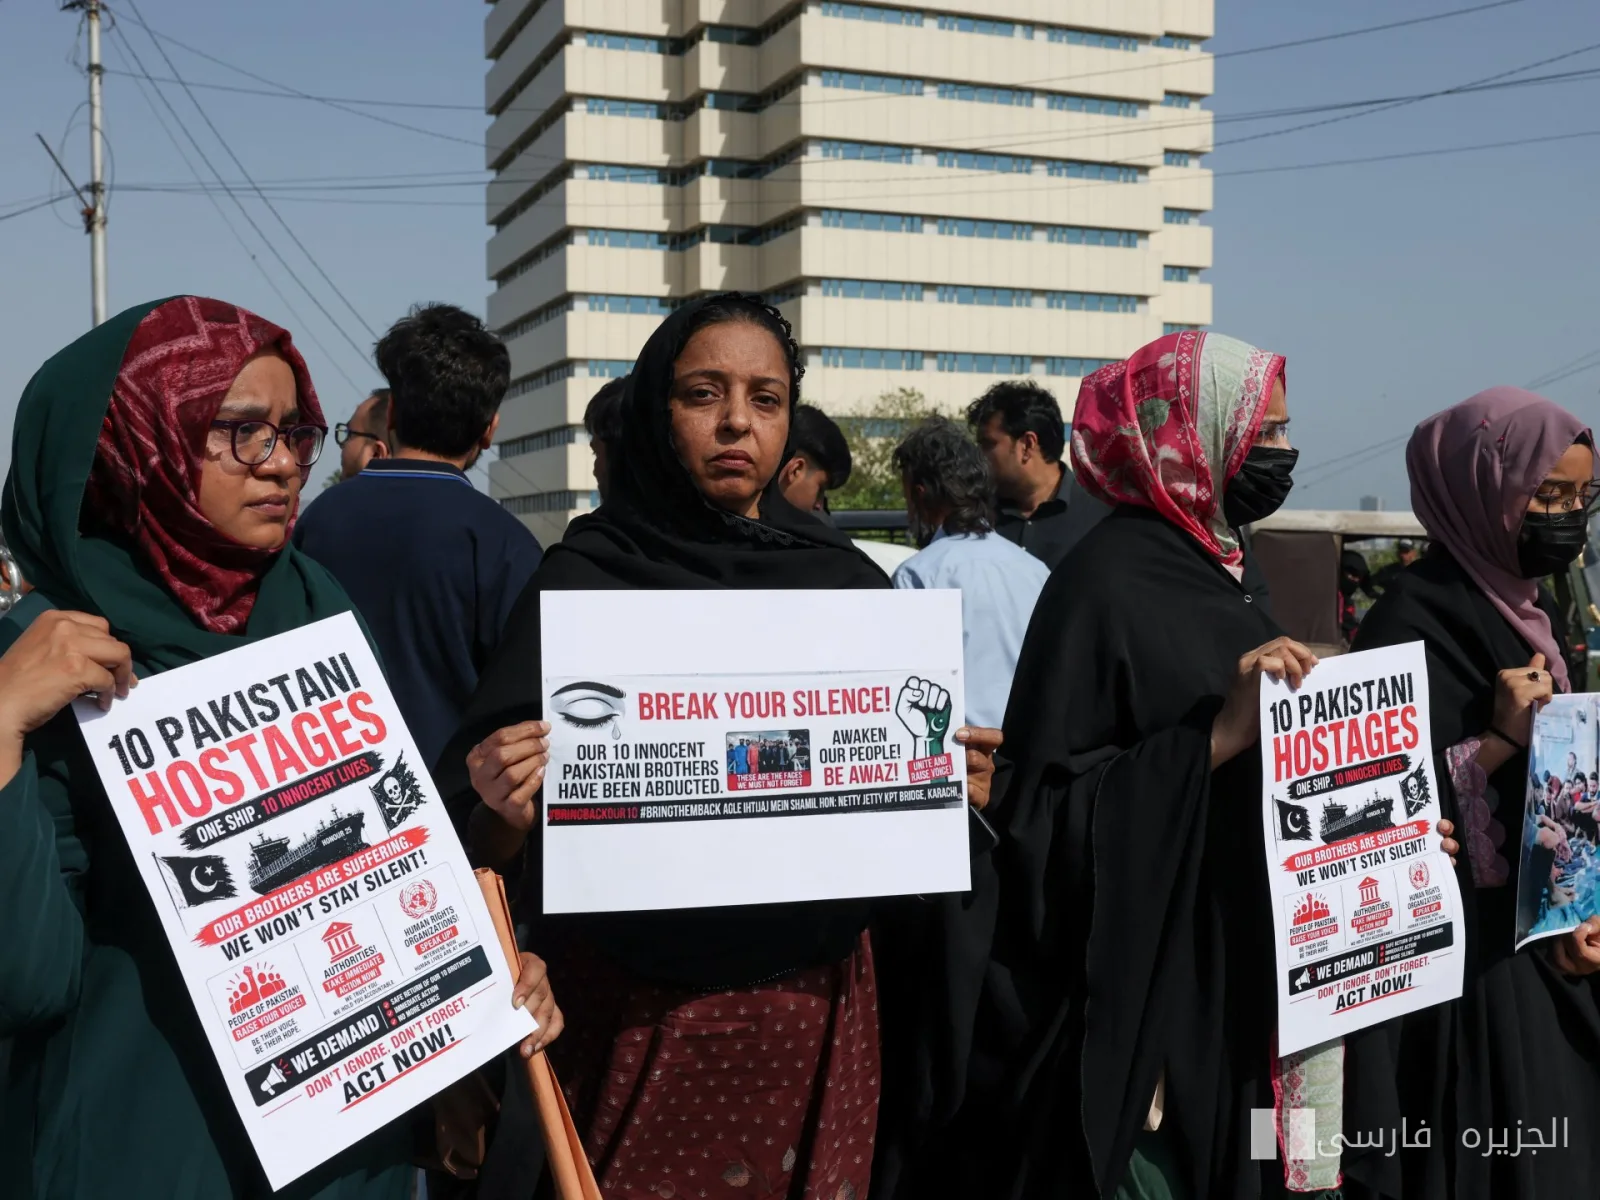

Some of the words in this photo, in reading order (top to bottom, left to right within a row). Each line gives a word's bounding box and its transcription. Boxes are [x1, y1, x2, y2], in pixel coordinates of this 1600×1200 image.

[105, 724, 156, 777] 10
[153, 651, 362, 759] PAKISTANI
[638, 692, 718, 720] BREAK
[724, 691, 786, 718] YOUR
[792, 686, 890, 716] SILENCE!
[1269, 696, 1292, 734] 10
[1298, 671, 1414, 727] PAKISTANI
[577, 744, 606, 760] OUR
[612, 743, 629, 760] 10
[634, 741, 705, 759] INNOCENT
[819, 747, 845, 763] OUR
[849, 743, 900, 761] PEOPLE!
[832, 727, 886, 745] AWAKEN
[1272, 704, 1419, 782] HOSTAGES
[124, 689, 390, 836] HOSTAGES
[562, 762, 639, 780] PAKISTANI
[644, 759, 718, 778] BROTHERS
[736, 773, 756, 781] THESE
[757, 772, 769, 780] ARE
[783, 771, 802, 779] FACES
[823, 766, 844, 786] BE
[849, 762, 898, 784] AWAZ!
[910, 769, 930, 781] RAISE
[912, 757, 933, 771] UNITE
[934, 755, 947, 766] AND
[1295, 778, 1311, 796] ONE
[1312, 773, 1333, 792] SHIP.
[1334, 771, 1344, 786] 10
[1344, 761, 1381, 784] INNOCENT
[1382, 756, 1404, 774] LIVES.
[194, 817, 227, 843] ONE
[223, 803, 262, 831] SHIP.
[260, 795, 279, 816] 10
[276, 770, 338, 809] INNOCENT
[335, 757, 374, 784] LIVES.
[558, 782, 597, 799] HAVE
[602, 781, 640, 798] BEEN
[644, 778, 723, 796] ABDUCTED.
[737, 781, 746, 789] WE
[748, 780, 764, 788] MUST
[766, 779, 778, 787] NOT
[640, 802, 721, 818] #BRINGTHEMBACK
[770, 799, 789, 811] MEIN
[790, 797, 818, 810] SHAMIL
[819, 796, 836, 808] HON:
[837, 794, 861, 806] NETTY
[862, 792, 883, 805] JETTY
[884, 791, 897, 803] KPT
[899, 789, 926, 801] BRIDGE,
[320, 829, 345, 847] HONOUR
[343, 825, 353, 835] 25
[1294, 852, 1313, 868] OUR
[1314, 840, 1358, 863] BROTHERS
[1359, 835, 1375, 850] ARE
[1377, 823, 1420, 845] SUFFERING.
[1296, 868, 1316, 887] WE
[1317, 856, 1357, 881] WON'T
[1360, 848, 1386, 870] STAY
[1388, 837, 1426, 861] SILENT!
[212, 913, 244, 939] OUR
[243, 879, 314, 924] BROTHERS
[314, 866, 343, 891] ARE
[341, 833, 413, 877] SUFFERING.
[220, 932, 254, 962] WE
[253, 901, 316, 945] WON'T
[317, 879, 362, 914] STAY
[362, 848, 428, 892] SILENT!
[403, 918, 430, 937] HUMAN
[429, 905, 455, 923] RIGHTS
[403, 913, 459, 948] ORGANIZATIONS!
[419, 935, 441, 952] SPEAK
[441, 928, 453, 940] UP!
[1289, 924, 1307, 935] PEOPLE
[1307, 922, 1313, 930] OF
[323, 944, 377, 979] AUTHORITIES!
[325, 974, 345, 990] TAKE
[344, 955, 381, 980] IMMEDIATE
[1316, 962, 1331, 981] WE
[1332, 950, 1373, 976] DEMAND
[1317, 981, 1340, 1000] DON'T
[1343, 972, 1372, 992] IGNORE.
[1374, 964, 1397, 981] DON'T
[1399, 954, 1429, 974] FORGET.
[338, 977, 362, 995] ACTION
[361, 968, 378, 982] NOW!
[390, 993, 404, 1005] SAFE
[403, 982, 423, 998] RETURN
[422, 978, 430, 987] OF
[429, 972, 441, 983] OUR
[440, 969, 448, 977] 10
[446, 955, 472, 974] BROTHERS
[1335, 986, 1366, 1010] ACT
[1370, 972, 1412, 999] NOW!
[227, 1007, 256, 1029] PEOPLE
[255, 1002, 265, 1014] OF
[265, 984, 301, 1009] PAKISTAN!
[393, 993, 421, 1013] IMMEDIATE
[420, 983, 439, 998] ACTION
[397, 1012, 406, 1022] NO
[405, 1004, 421, 1017] MORE
[419, 993, 440, 1009] SILENCE
[235, 1019, 259, 1039] RAISE
[258, 1009, 279, 1026] YOUR
[278, 996, 303, 1016] VOICE!
[251, 1036, 260, 1046] BE
[260, 1027, 278, 1041] THEIR
[254, 1044, 264, 1055] BE
[263, 1034, 282, 1049] THEIR
[290, 1046, 320, 1074] WE
[316, 1012, 380, 1061] DEMAND
[304, 1066, 343, 1099] DON'T
[342, 1040, 391, 1076] IGNORE.
[389, 1019, 425, 1049] DON'T
[424, 994, 470, 1029] FORGET.
[340, 1059, 390, 1105] ACT
[390, 1022, 456, 1074] NOW!
